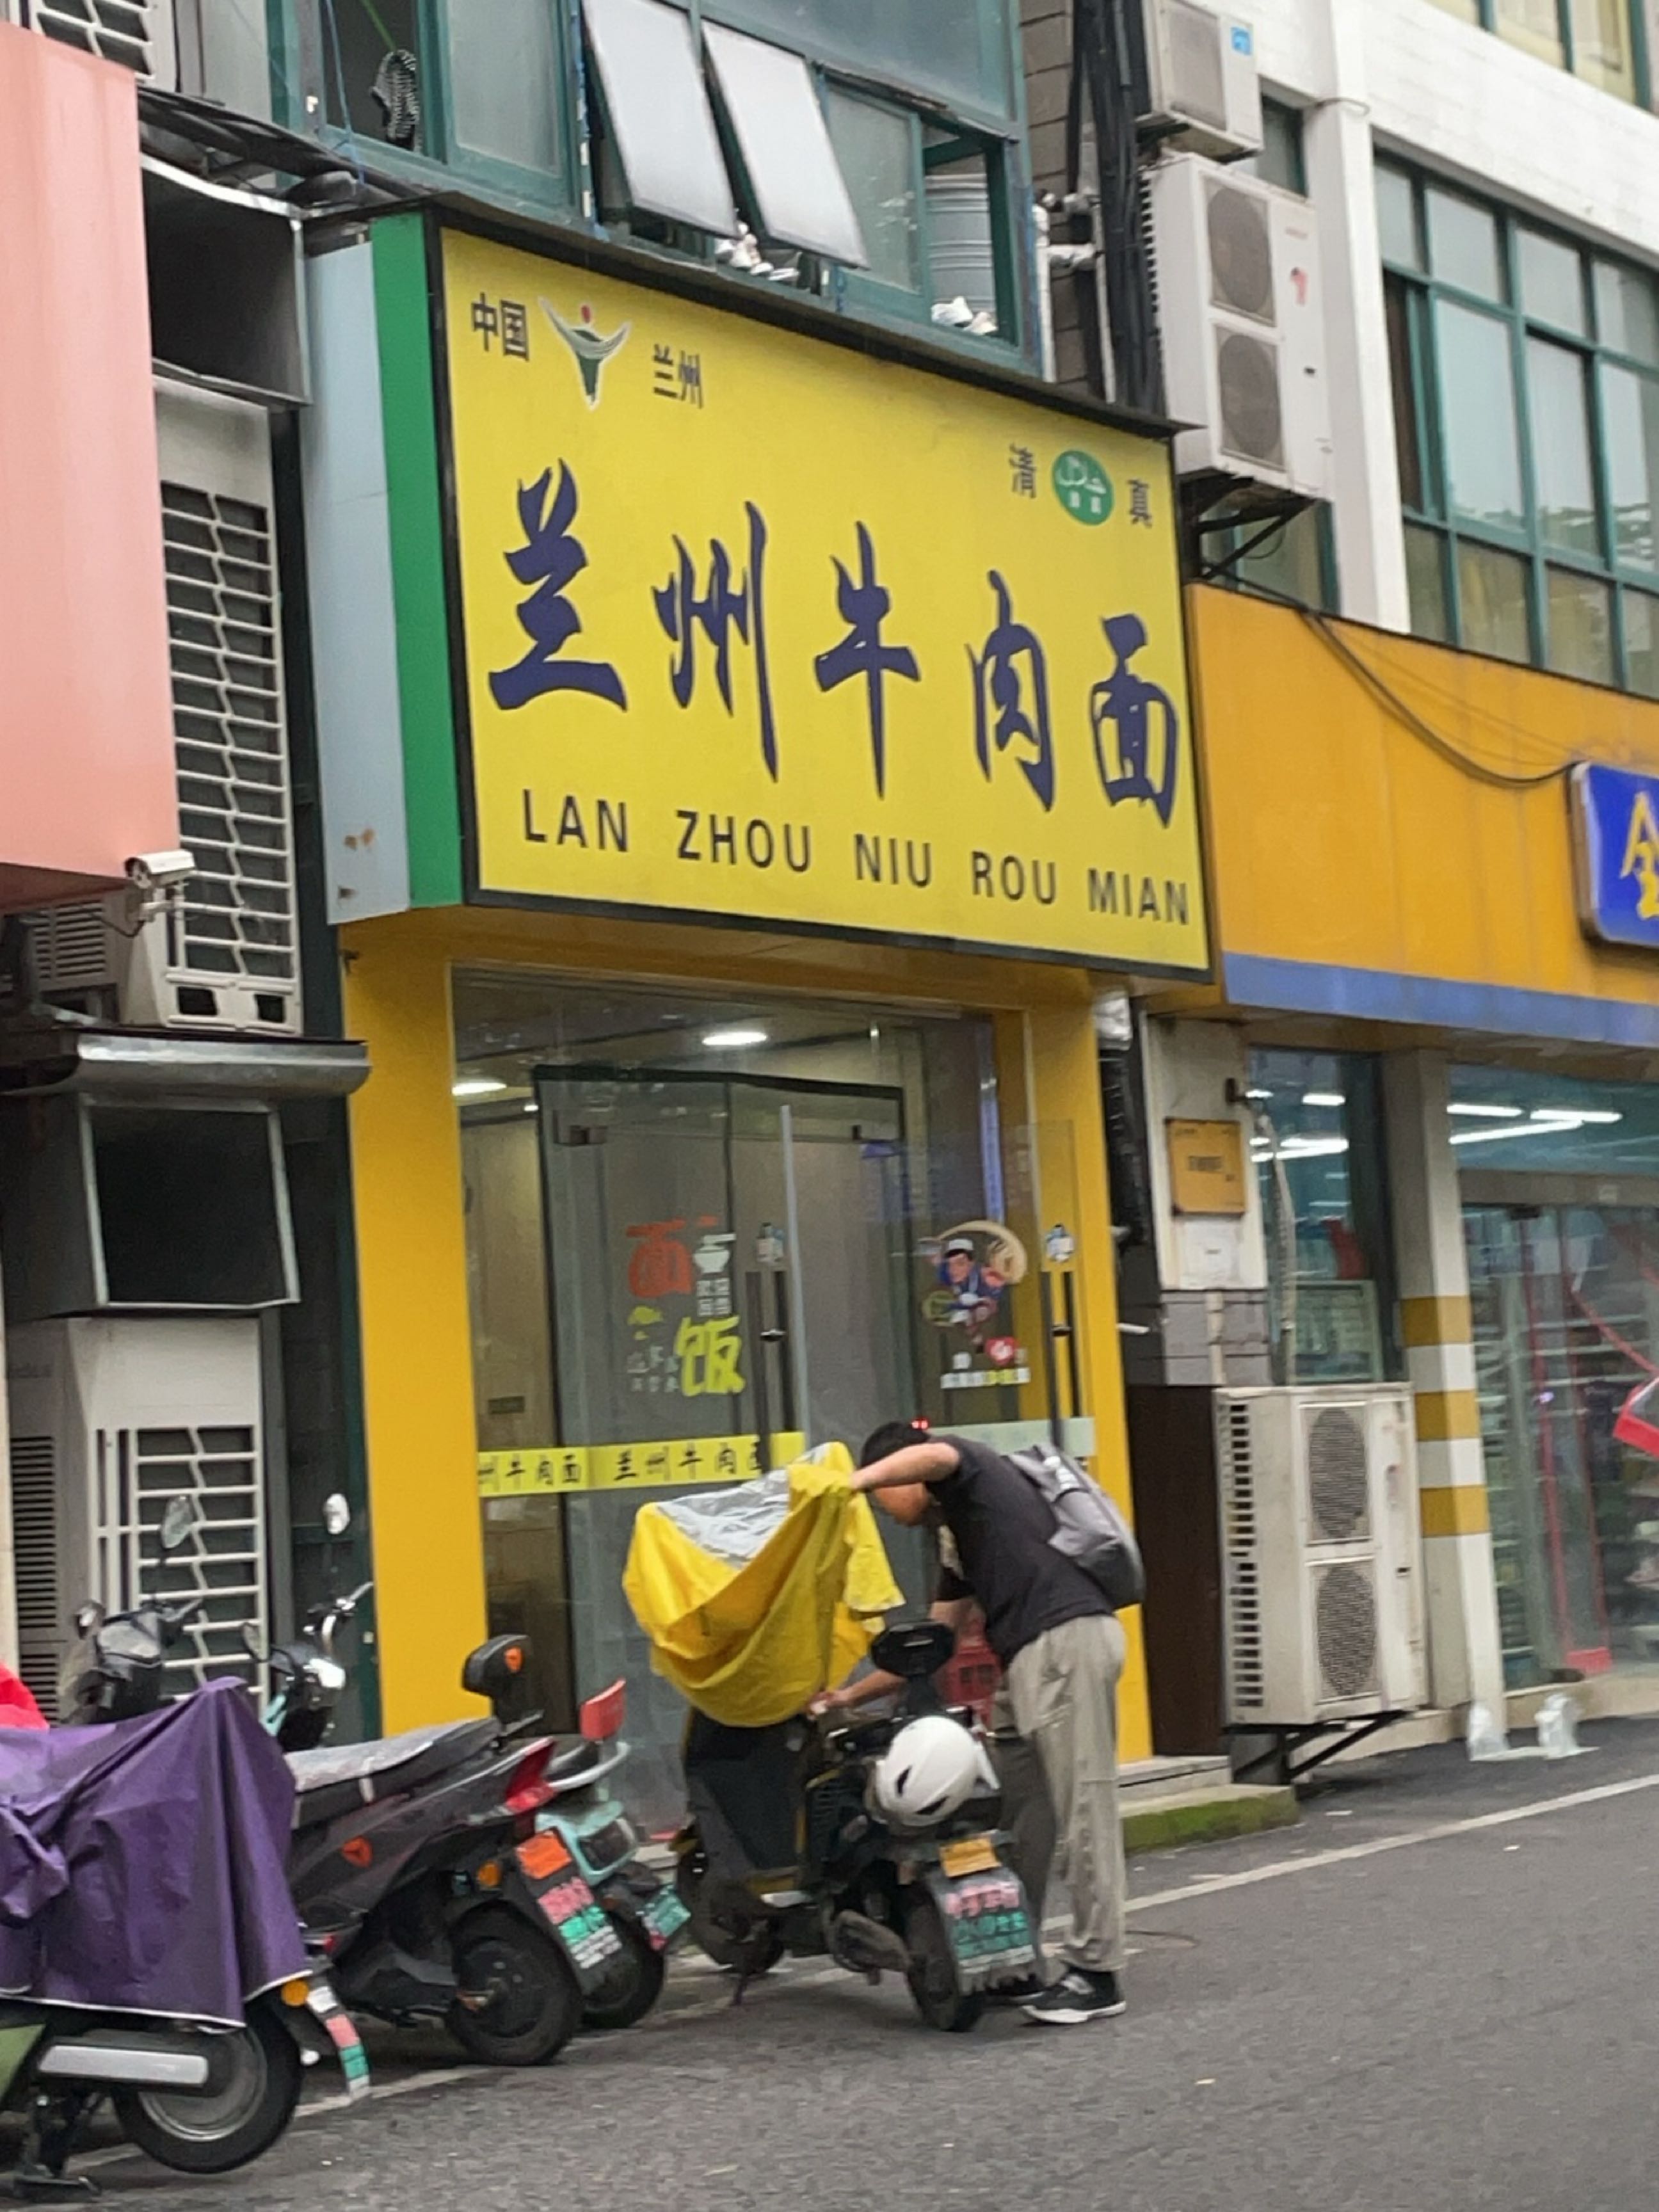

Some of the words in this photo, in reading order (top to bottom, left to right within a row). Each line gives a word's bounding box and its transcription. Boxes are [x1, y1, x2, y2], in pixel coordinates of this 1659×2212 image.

[470, 292, 529, 362] 中国
[652, 343, 703, 409] 兰州
[488, 457, 1180, 829] 兰州牛肉面
[522, 789, 628, 853] LAN
[676, 810, 811, 872] ZHOU
[854, 833, 931, 888] NIU
[972, 851, 1057, 906] ROU
[1087, 868, 1190, 926] MIAN
[674, 1314, 746, 1397] 饭
